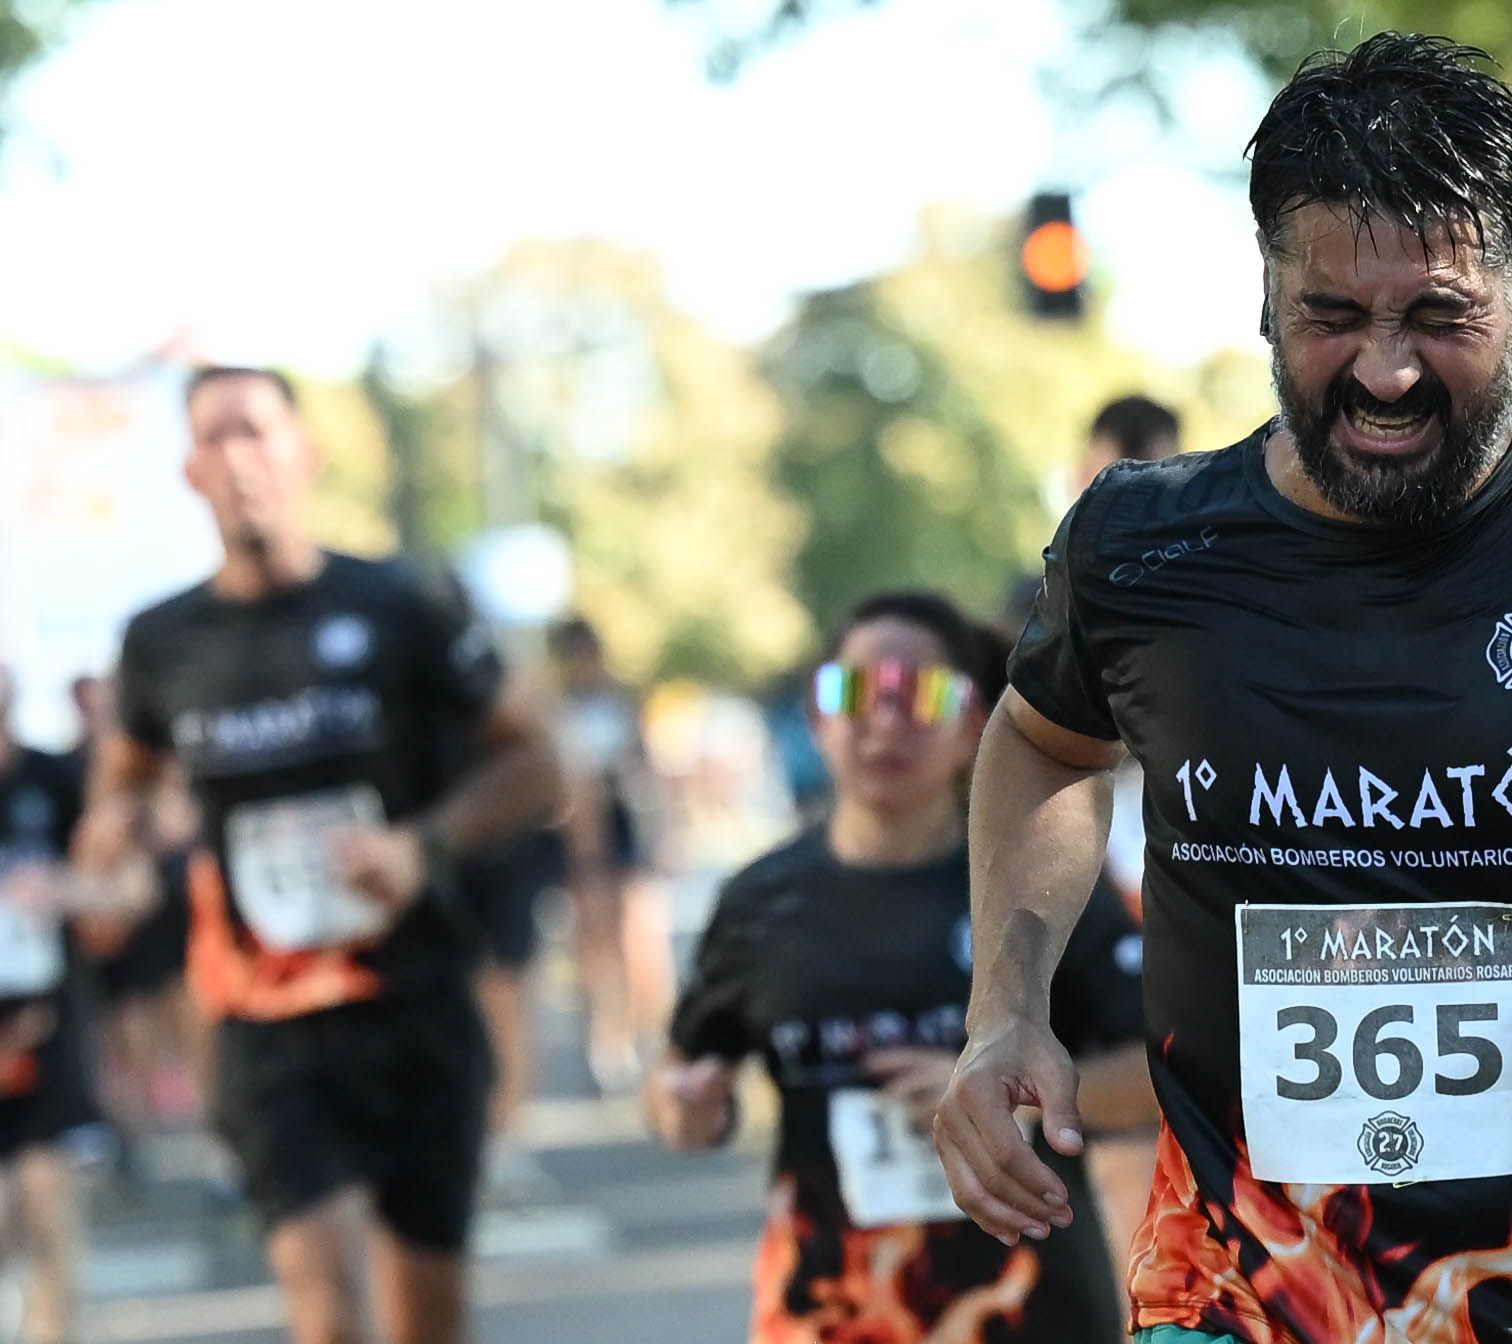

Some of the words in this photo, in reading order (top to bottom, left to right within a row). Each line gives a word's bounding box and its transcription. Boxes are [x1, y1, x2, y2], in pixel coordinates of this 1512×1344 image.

[1171, 842, 1267, 866] ASOCIACIÓN
[1270, 847, 1386, 868] BOMBEROS
[1320, 914, 1495, 961] MARATÓN
[1254, 966, 1321, 984] ASOCIACIÓN
[1324, 968, 1389, 984] BOMBEROS
[1392, 965, 1473, 983] VOLUNTARIOS
[1276, 1003, 1504, 1101] 365
[1378, 1131, 1404, 1153] 27
